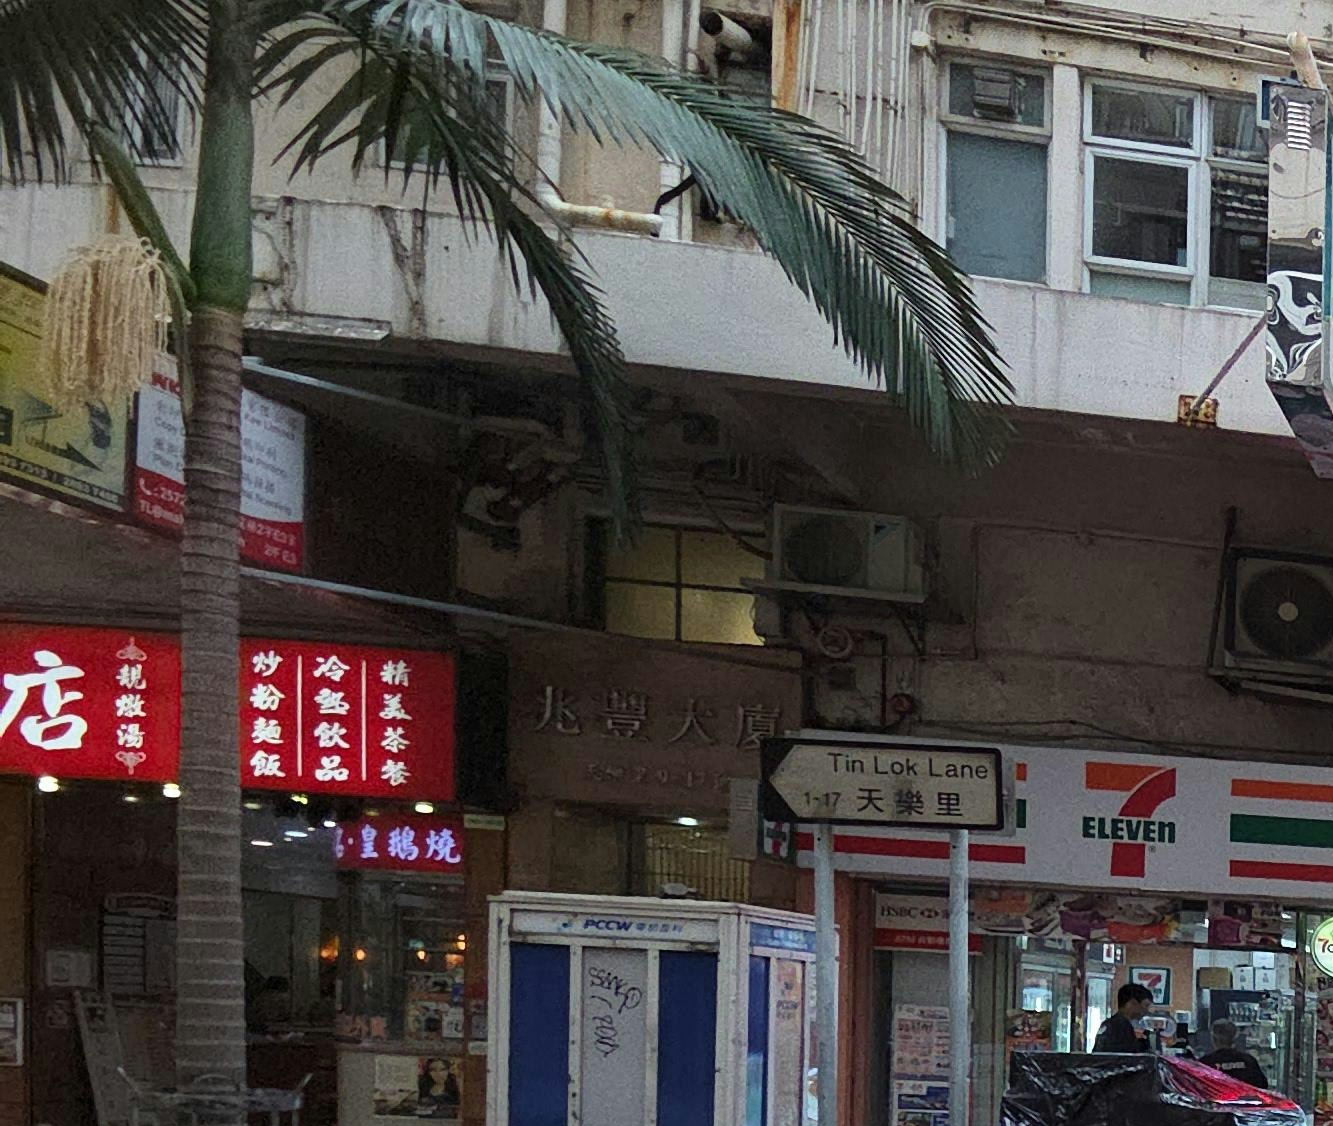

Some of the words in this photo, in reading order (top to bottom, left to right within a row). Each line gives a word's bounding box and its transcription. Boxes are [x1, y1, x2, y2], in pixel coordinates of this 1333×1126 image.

[0, 650, 88, 751] 店
[115, 663, 147, 749] 靚燉湯
[313, 655, 351, 782] 冷熱飲品
[379, 659, 412, 787] 精美茶餐
[827, 752, 865, 774] Tin
[874, 754, 918, 776] Lok
[929, 757, 989, 780] Lane
[803, 791, 842, 807] 1-17
[856, 788, 964, 818] 天樂里
[583, 919, 633, 932] PCCW
